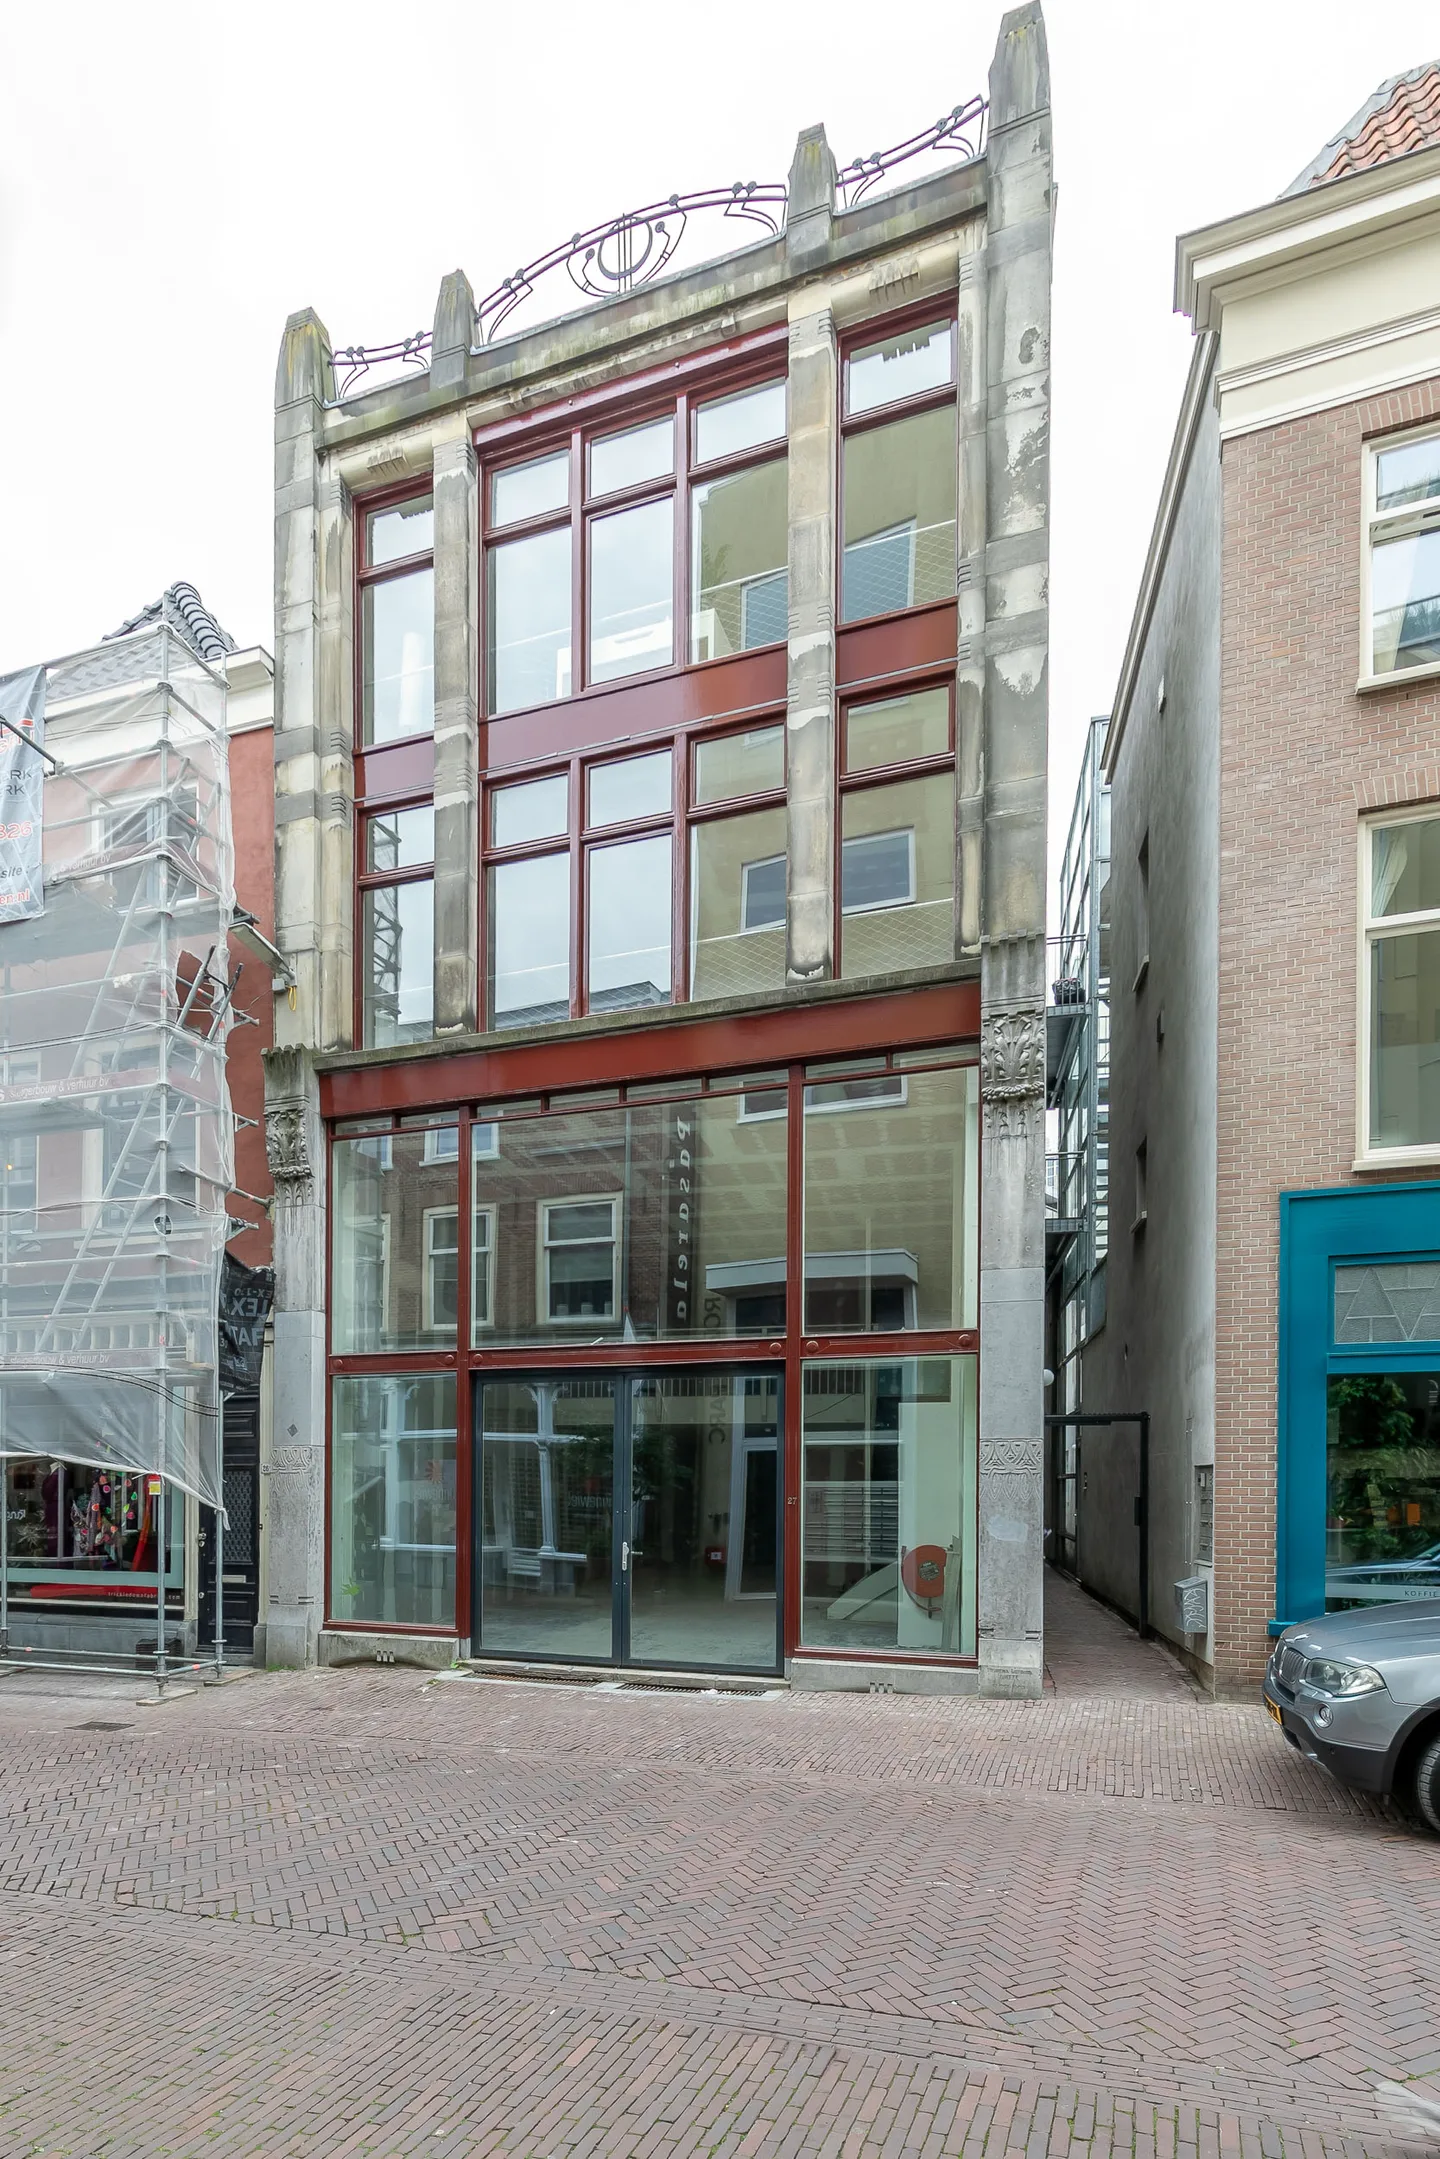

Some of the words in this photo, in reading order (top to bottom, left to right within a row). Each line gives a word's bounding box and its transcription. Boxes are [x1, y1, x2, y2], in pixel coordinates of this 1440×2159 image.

[66, 1353, 97, 1364] verhuur
[787, 1496, 798, 1505] 27
[1404, 1590, 1438, 1598] KOFFIE
